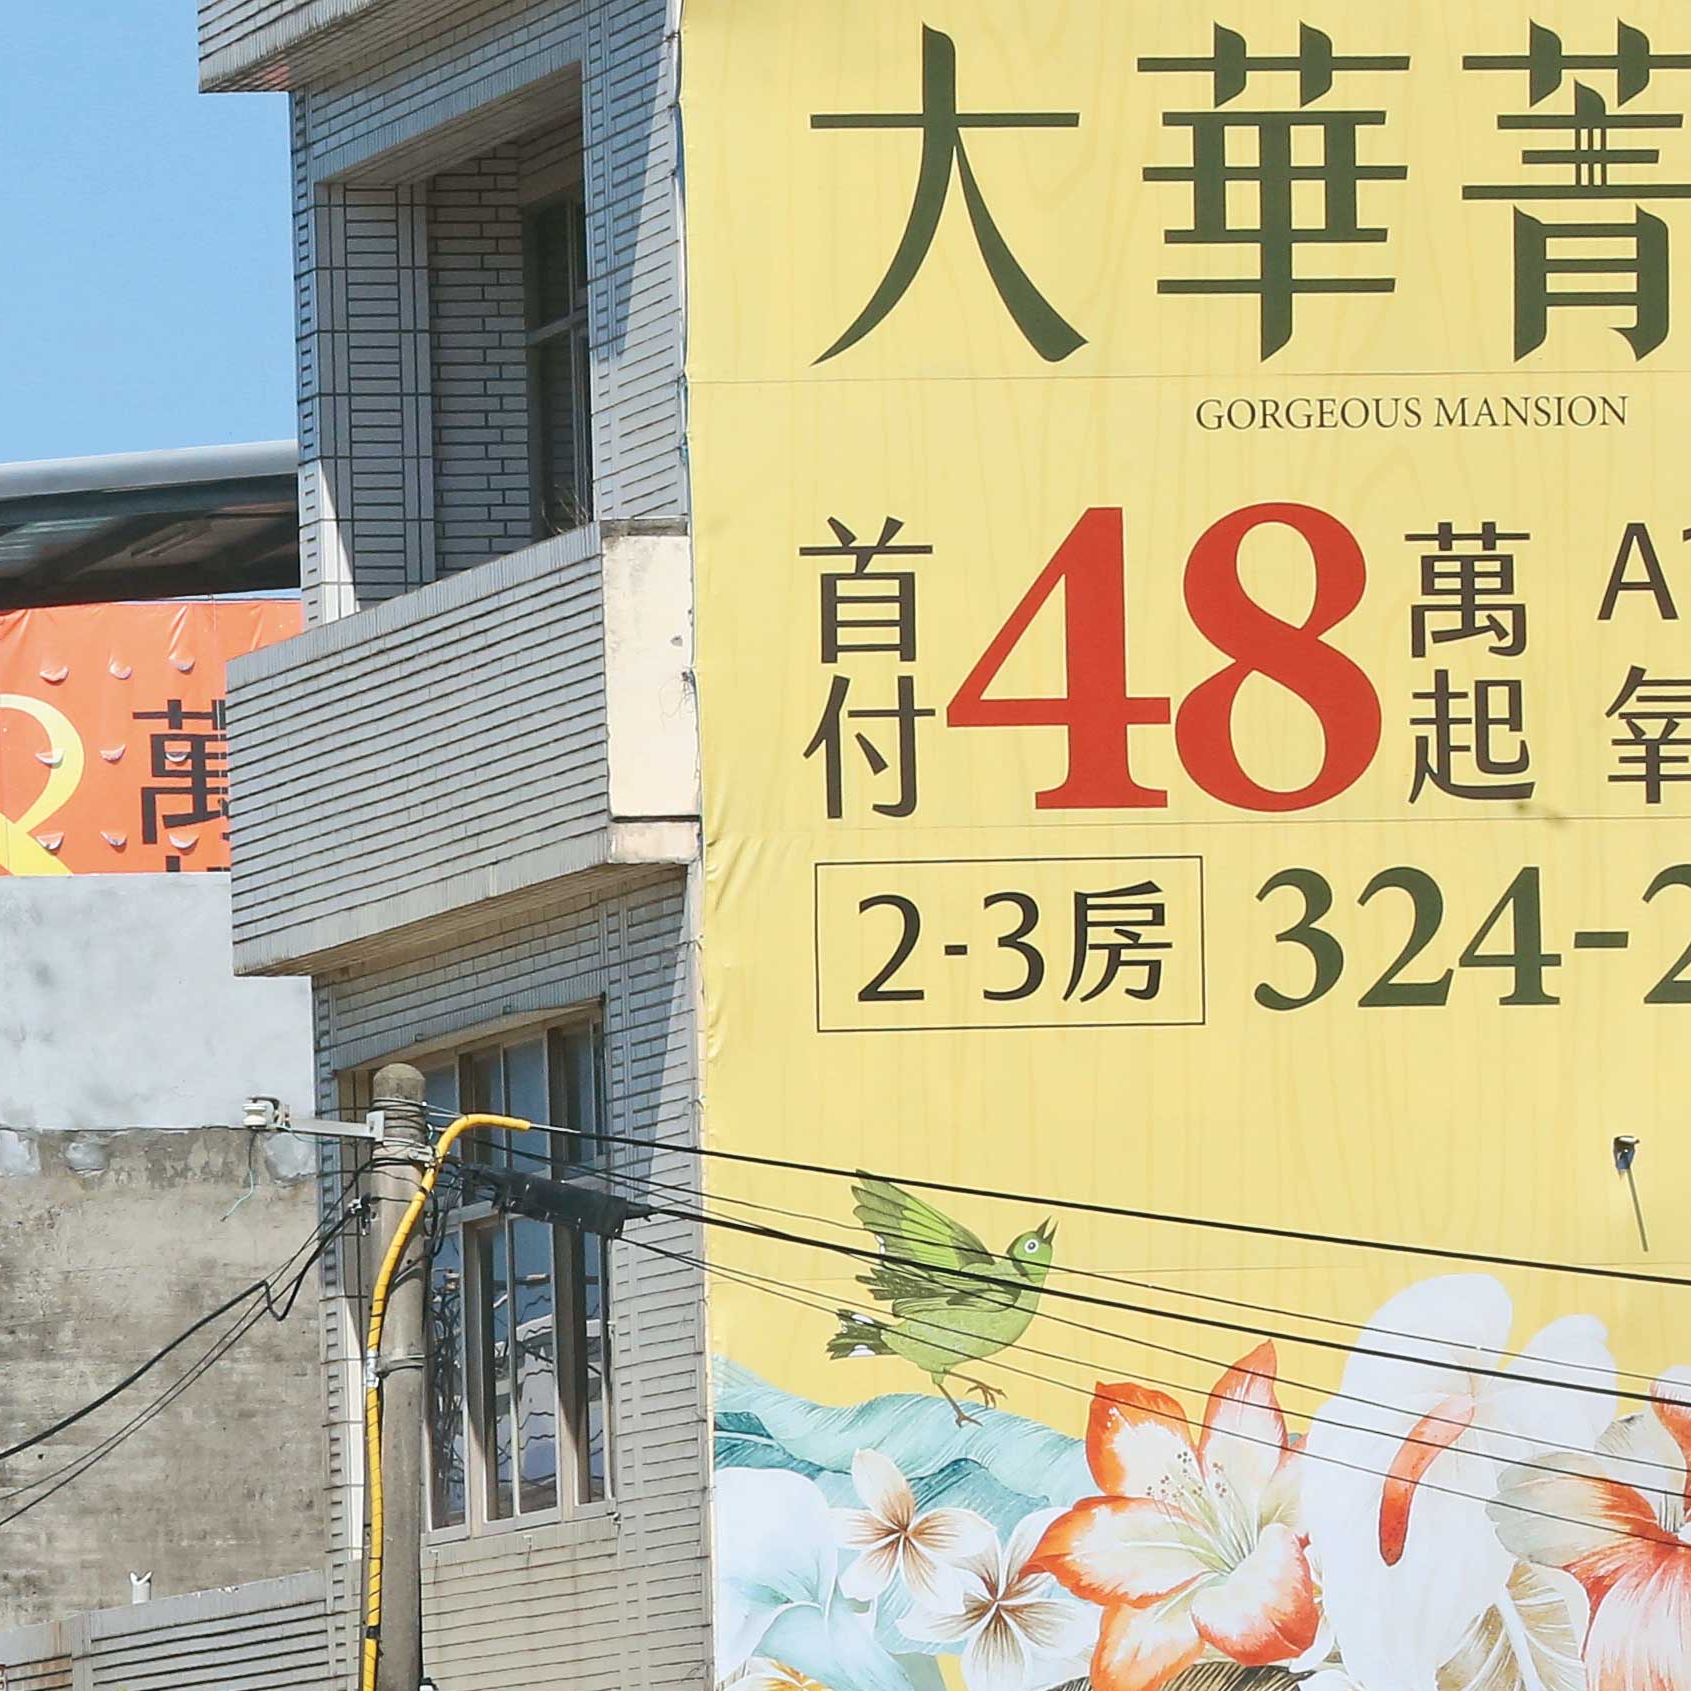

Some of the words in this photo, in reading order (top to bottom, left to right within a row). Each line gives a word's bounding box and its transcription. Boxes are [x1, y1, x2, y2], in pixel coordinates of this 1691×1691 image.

[809, 18, 1691, 366] 大華菁
[1195, 397, 1422, 431] GORGEOUS
[1432, 394, 1628, 429] MANSION
[799, 515, 936, 820] 首付
[945, 502, 1382, 813] 48
[1404, 520, 1537, 804] 萬起
[856, 881, 1173, 1006] 2-3房
